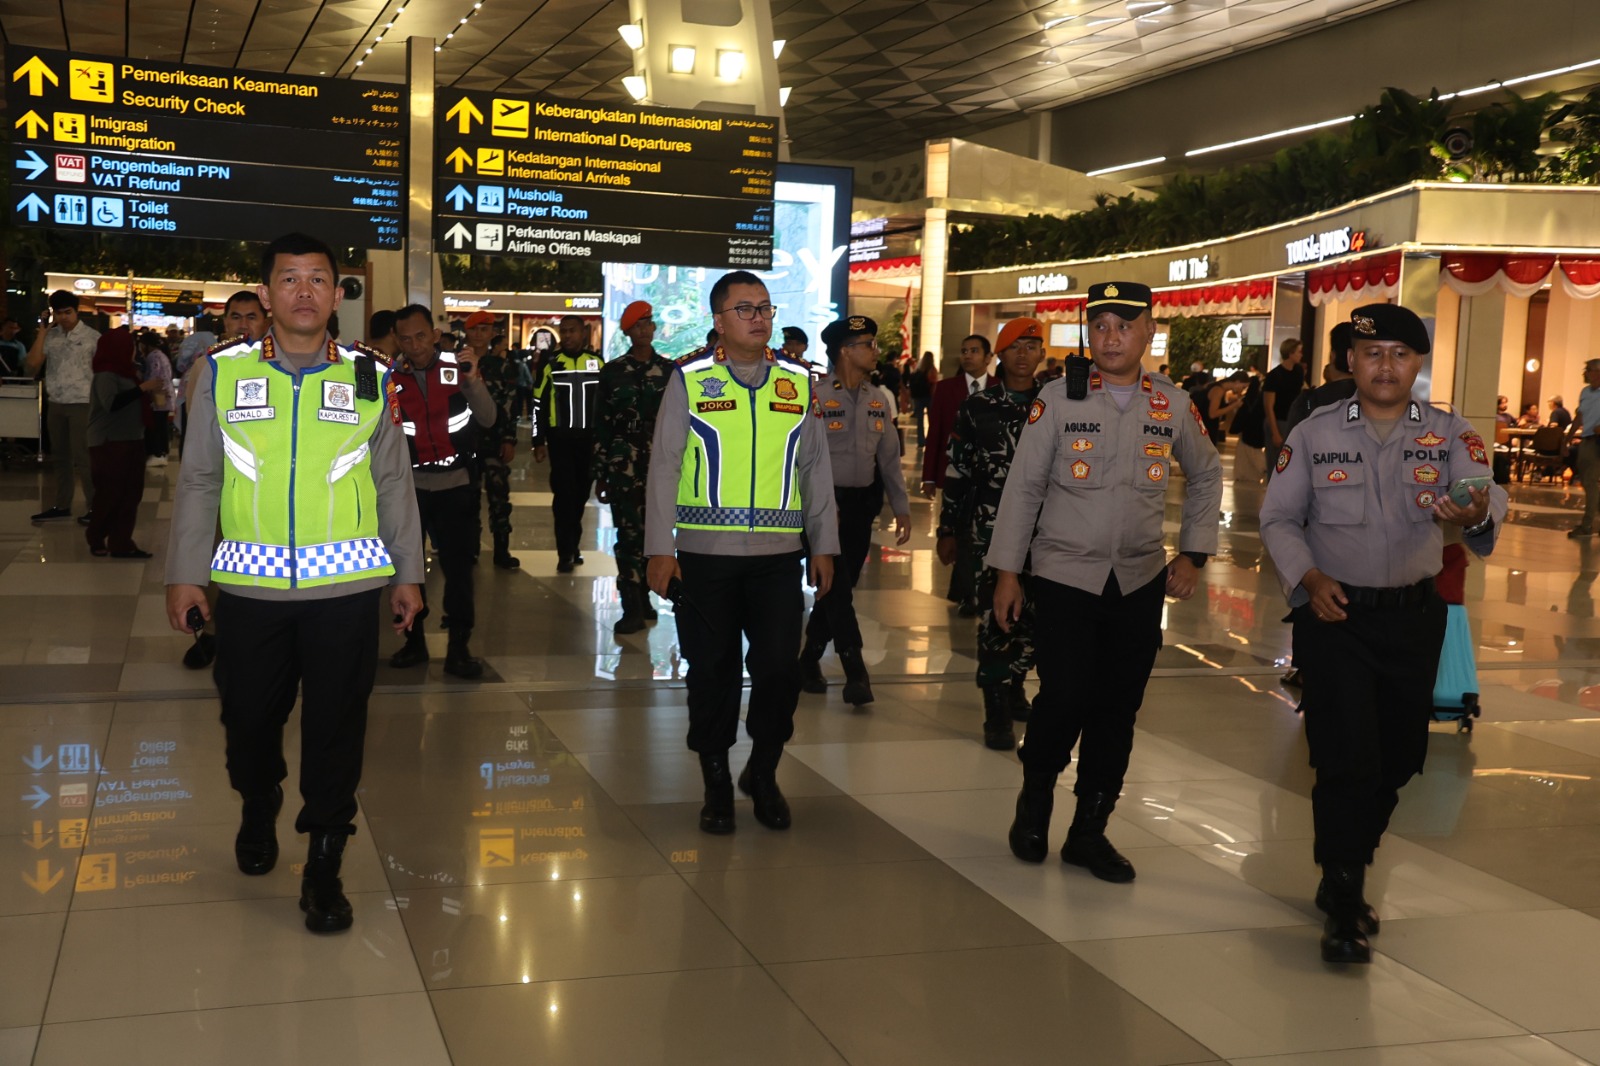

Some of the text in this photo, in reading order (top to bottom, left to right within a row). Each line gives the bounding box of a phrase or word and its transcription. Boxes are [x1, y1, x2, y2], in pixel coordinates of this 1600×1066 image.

[121, 65, 318, 98] Pemeriksaan Keamanan
[122, 91, 246, 116] Security Check
[90, 115, 148, 134] Imigrasi
[535, 102, 722, 132] Keberangkatan Internasional
[90, 132, 176, 152] Immigration
[534, 127, 692, 153] International Departures
[59, 157, 82, 168] VAT
[91, 156, 230, 180] Pengembalian PPN
[508, 150, 661, 173] Kedatangan Internasional
[92, 172, 180, 192] VAT Refund
[508, 167, 631, 186] International Arrivals
[508, 188, 564, 204] Musholla
[129, 200, 169, 215] Toilet
[508, 203, 588, 220] Prayer Room
[129, 216, 176, 232] Toilets
[507, 226, 642, 246] Perkantoran Maskapai
[507, 242, 592, 257] Airline Offices
[268, 408, 273, 416] S
[700, 401, 732, 410] JOKO
[320, 412, 357, 420] KAPOLRESTA
[1064, 422, 1100, 433] AGUS.DC
[1144, 424, 1173, 438] POLRI
